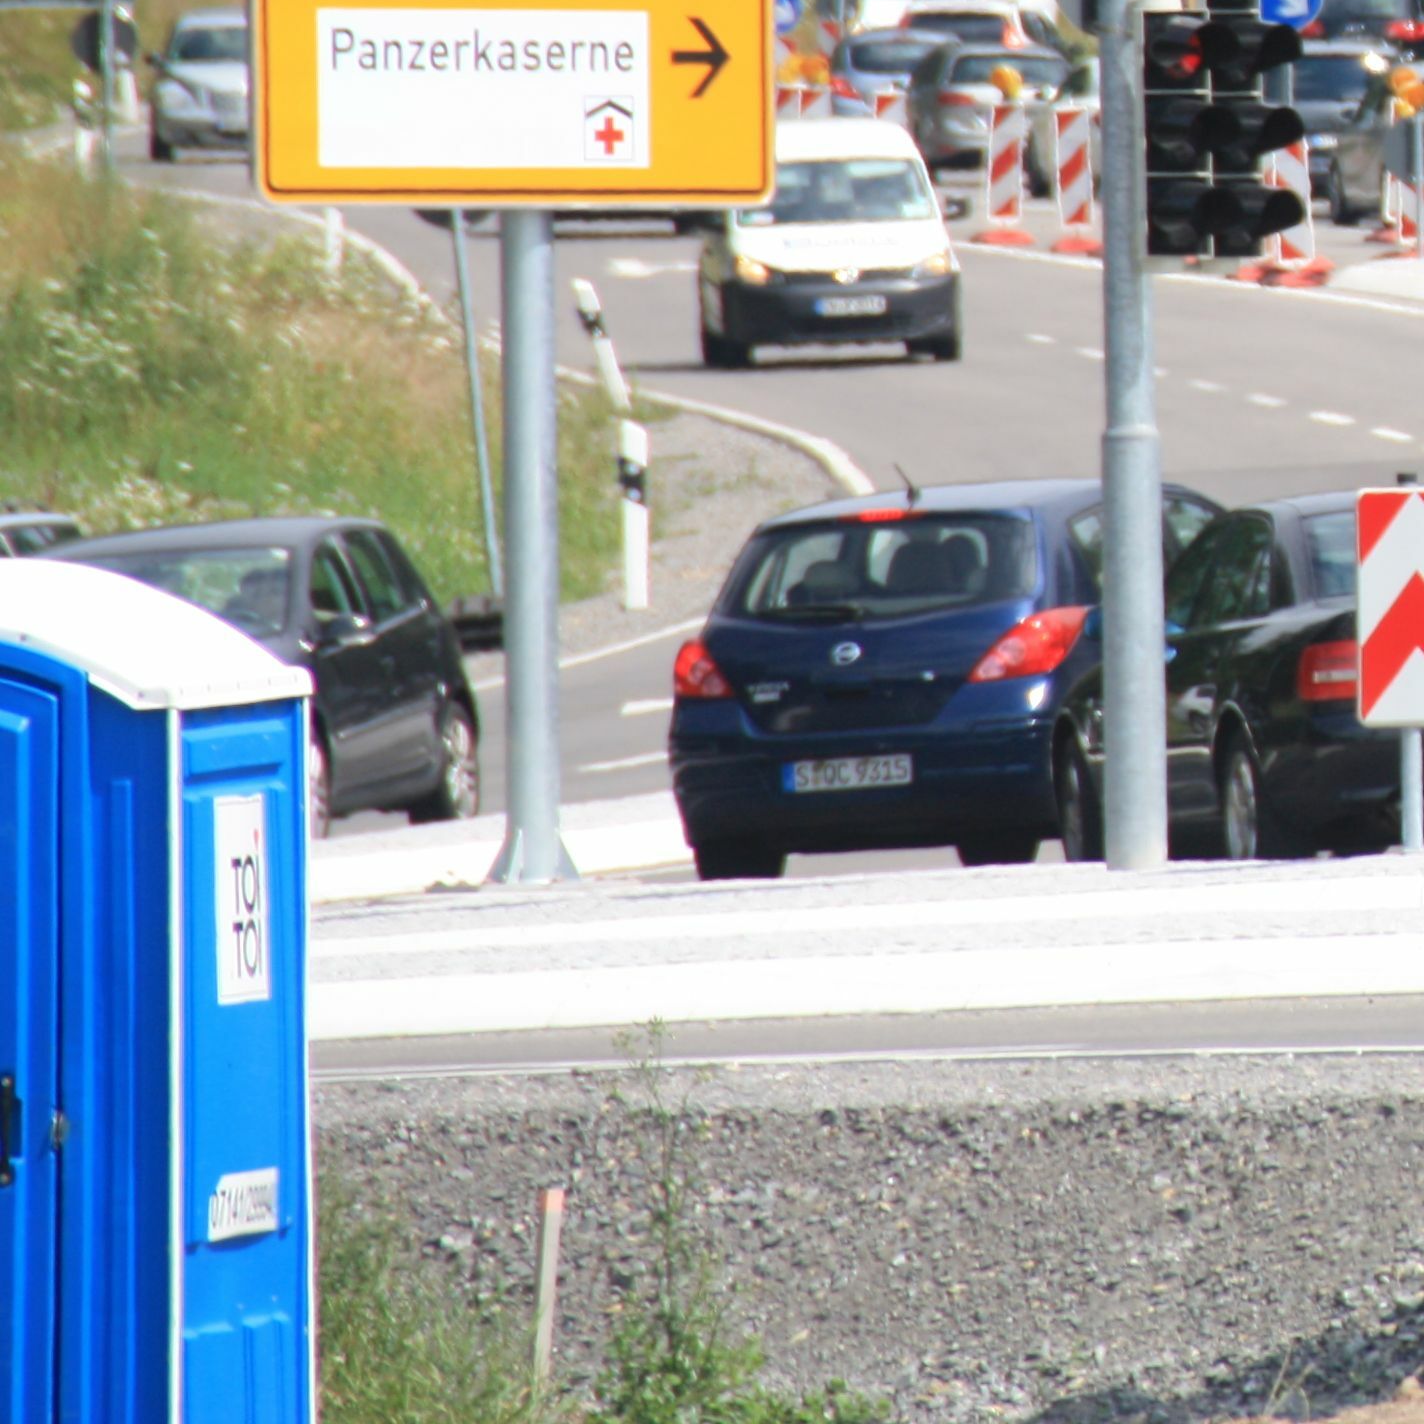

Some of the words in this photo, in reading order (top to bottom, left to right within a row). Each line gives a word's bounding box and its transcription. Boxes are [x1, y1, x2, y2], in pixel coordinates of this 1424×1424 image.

[331, 27, 635, 73] Panzerkaserne
[795, 764, 810, 789] S
[855, 756, 909, 787] 9315
